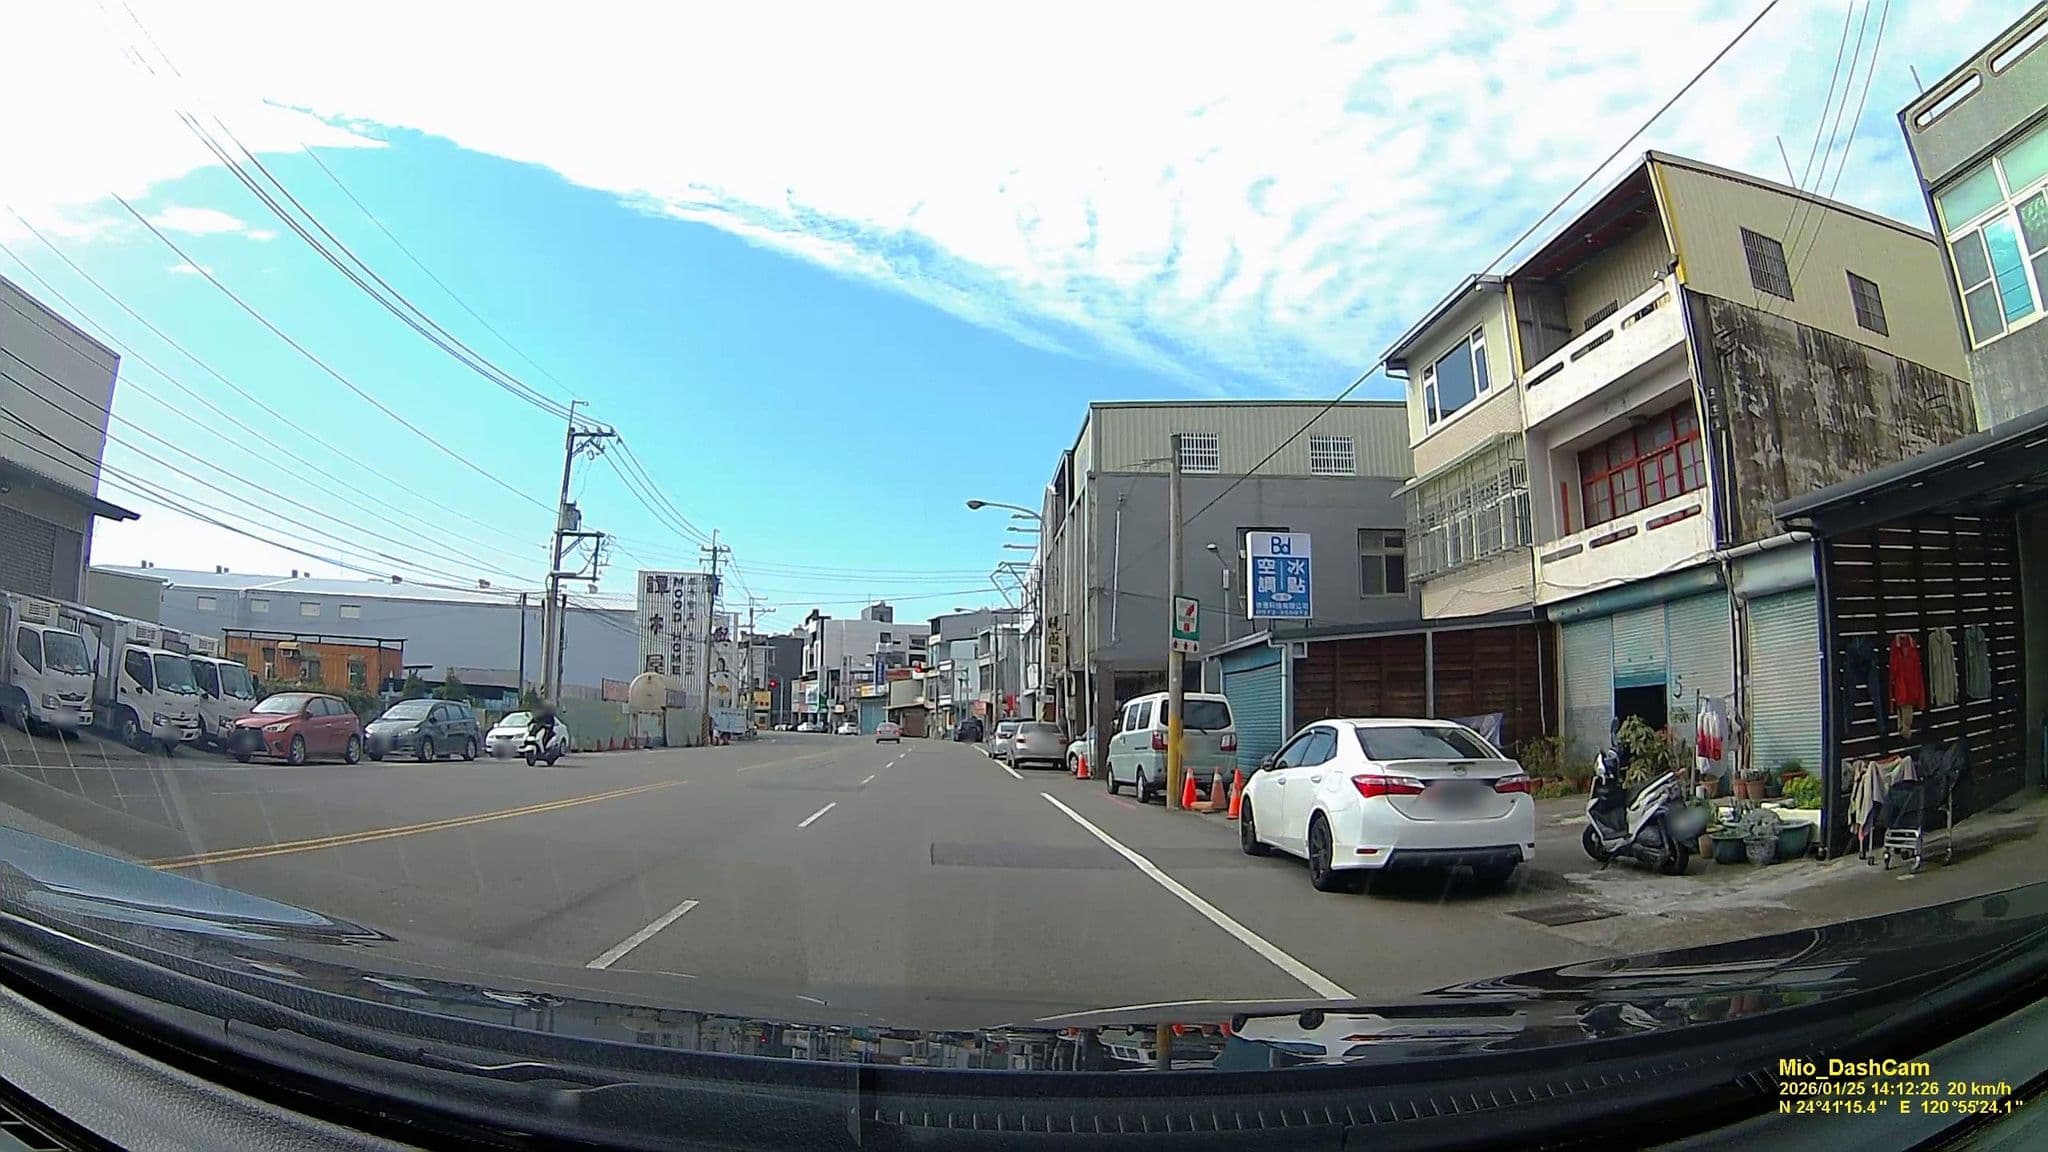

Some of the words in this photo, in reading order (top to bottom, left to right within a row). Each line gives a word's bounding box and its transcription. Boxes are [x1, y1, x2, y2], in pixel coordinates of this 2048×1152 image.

[1271, 536, 1291, 555] Bd
[1257, 559, 1276, 593] 空調
[673, 577, 684, 622] MOOD
[671, 632, 682, 675] HOME
